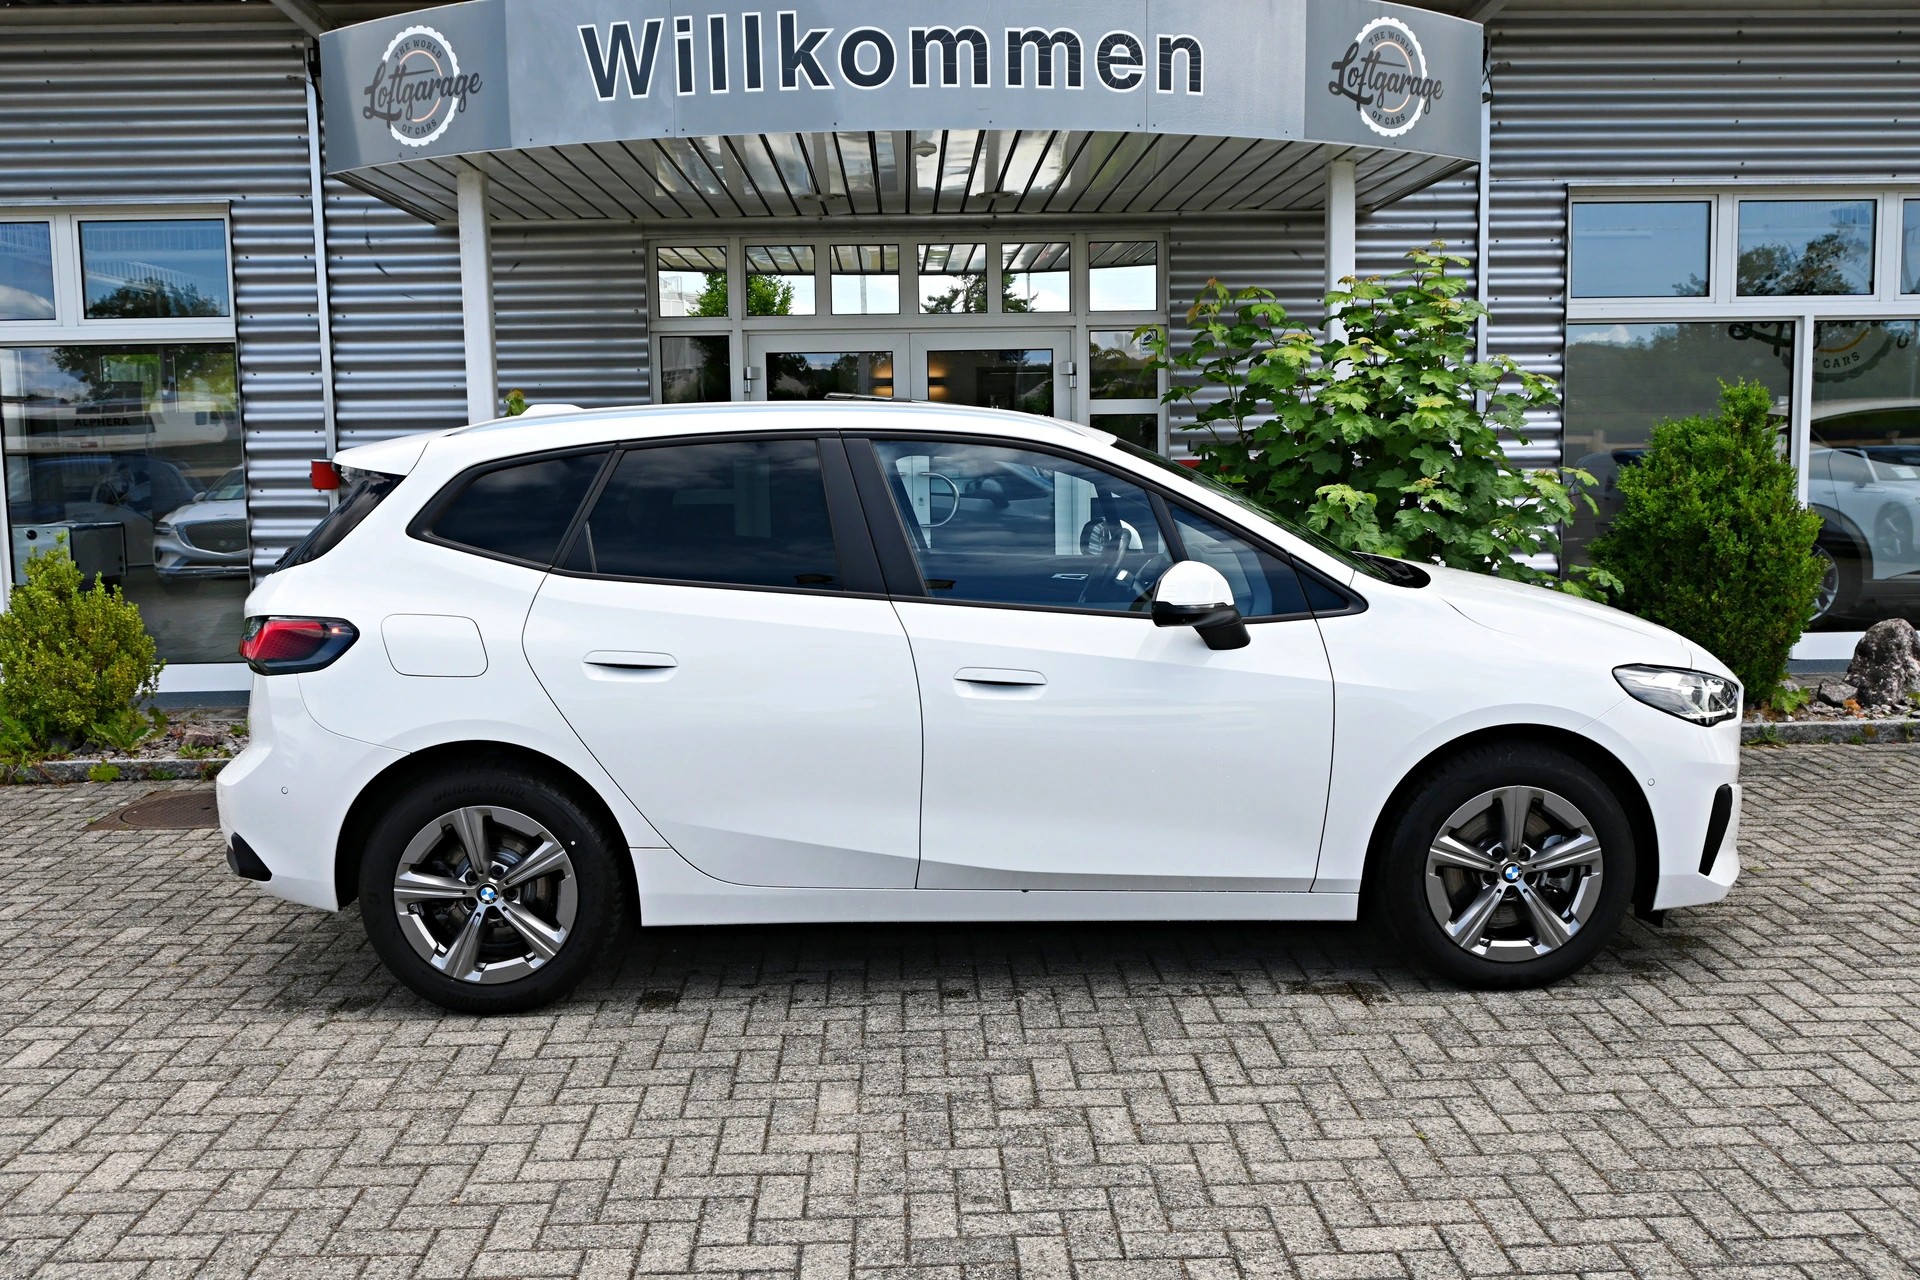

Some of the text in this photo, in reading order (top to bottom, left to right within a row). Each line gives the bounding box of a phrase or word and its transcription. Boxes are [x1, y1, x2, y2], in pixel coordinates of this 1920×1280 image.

[394, 40, 442, 60] THE WORLD
[1368, 31, 1413, 57] THE WORLD
[577, 10, 1204, 101] Willkommen
[1328, 41, 1444, 114] Loftgarage
[363, 61, 483, 129] Loftgarage
[401, 119, 437, 135] OF CARS
[1371, 110, 1406, 125] OF CARS
[1823, 351, 1860, 369] CARS
[74, 417, 130, 427] ALPHERA
